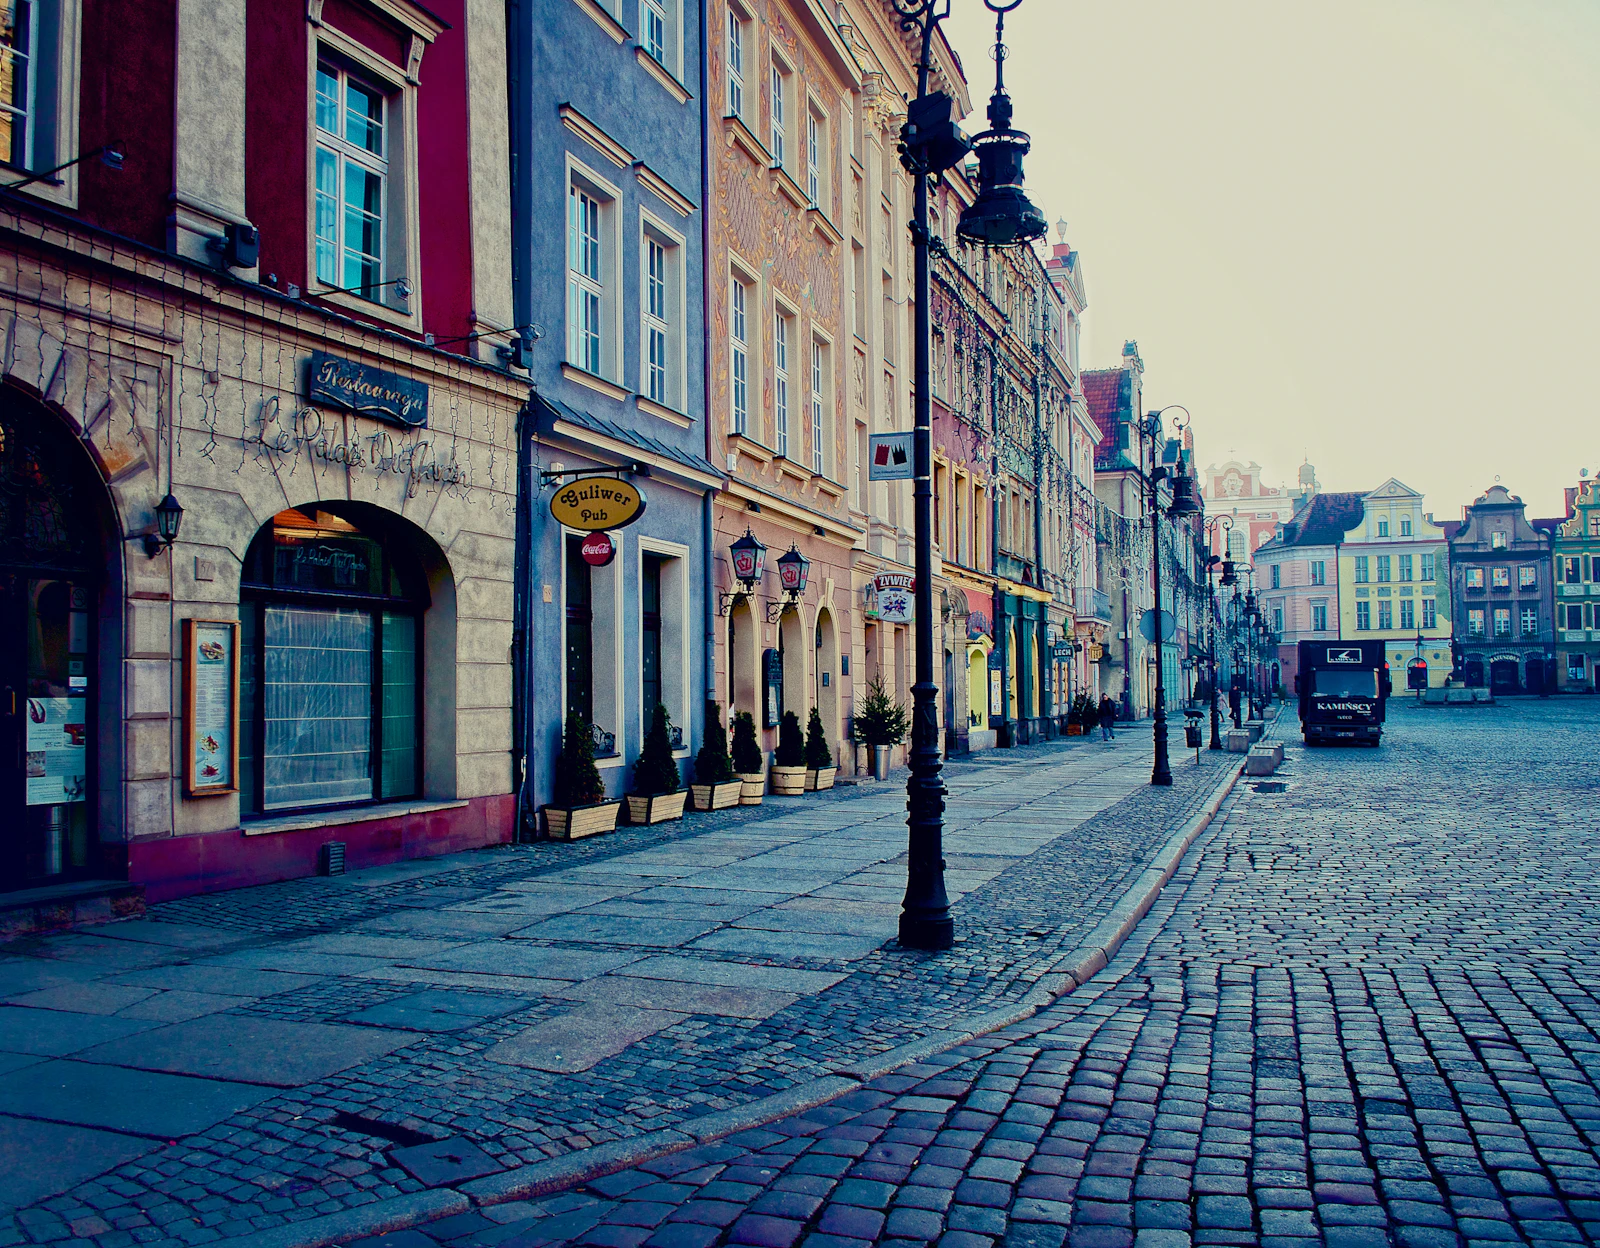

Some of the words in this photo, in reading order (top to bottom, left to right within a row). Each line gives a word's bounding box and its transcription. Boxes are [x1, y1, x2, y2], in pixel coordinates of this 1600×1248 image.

[249, 395, 293, 454] Le
[560, 484, 632, 508] Guliwer
[580, 508, 608, 523] Pub
[1054, 648, 1072, 656] LECH
